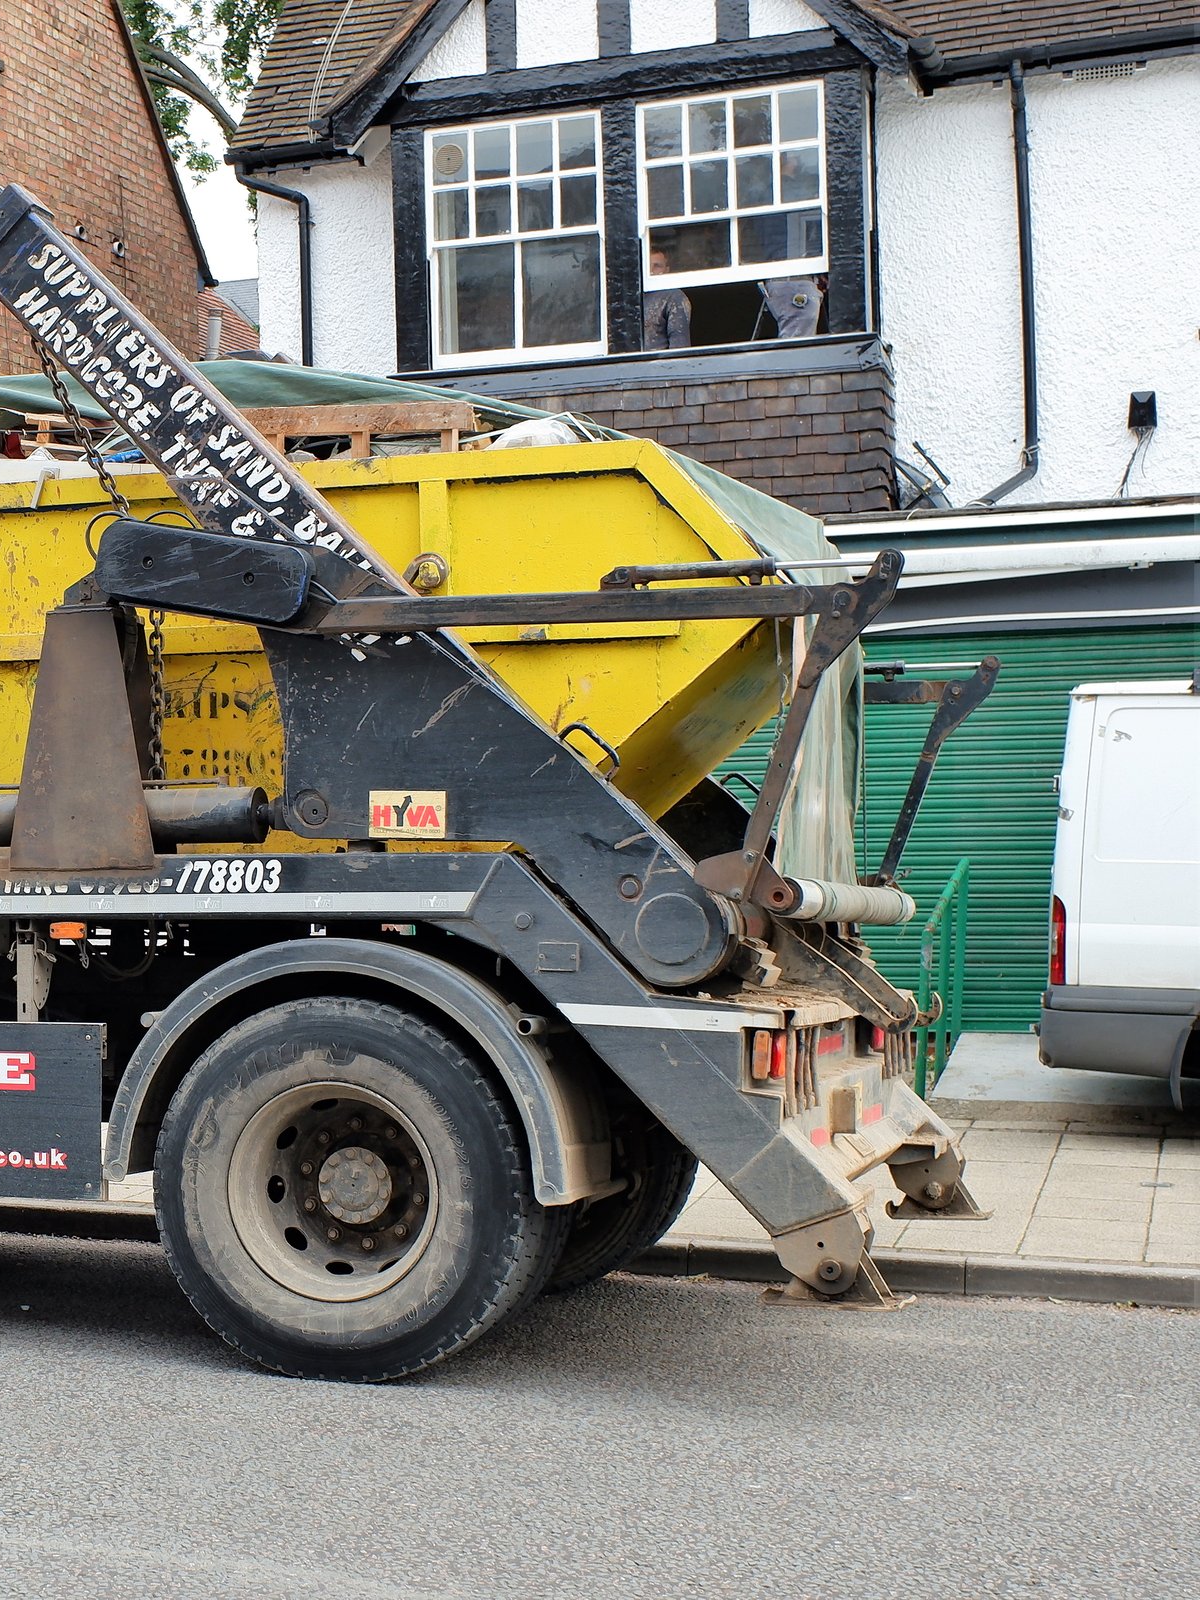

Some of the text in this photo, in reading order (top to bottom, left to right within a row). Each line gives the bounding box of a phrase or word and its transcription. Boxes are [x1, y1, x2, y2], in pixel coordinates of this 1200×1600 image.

[28, 244, 177, 388] SUPPLIERS
[170, 385, 218, 425] OF
[372, 795, 441, 828] HYVA
